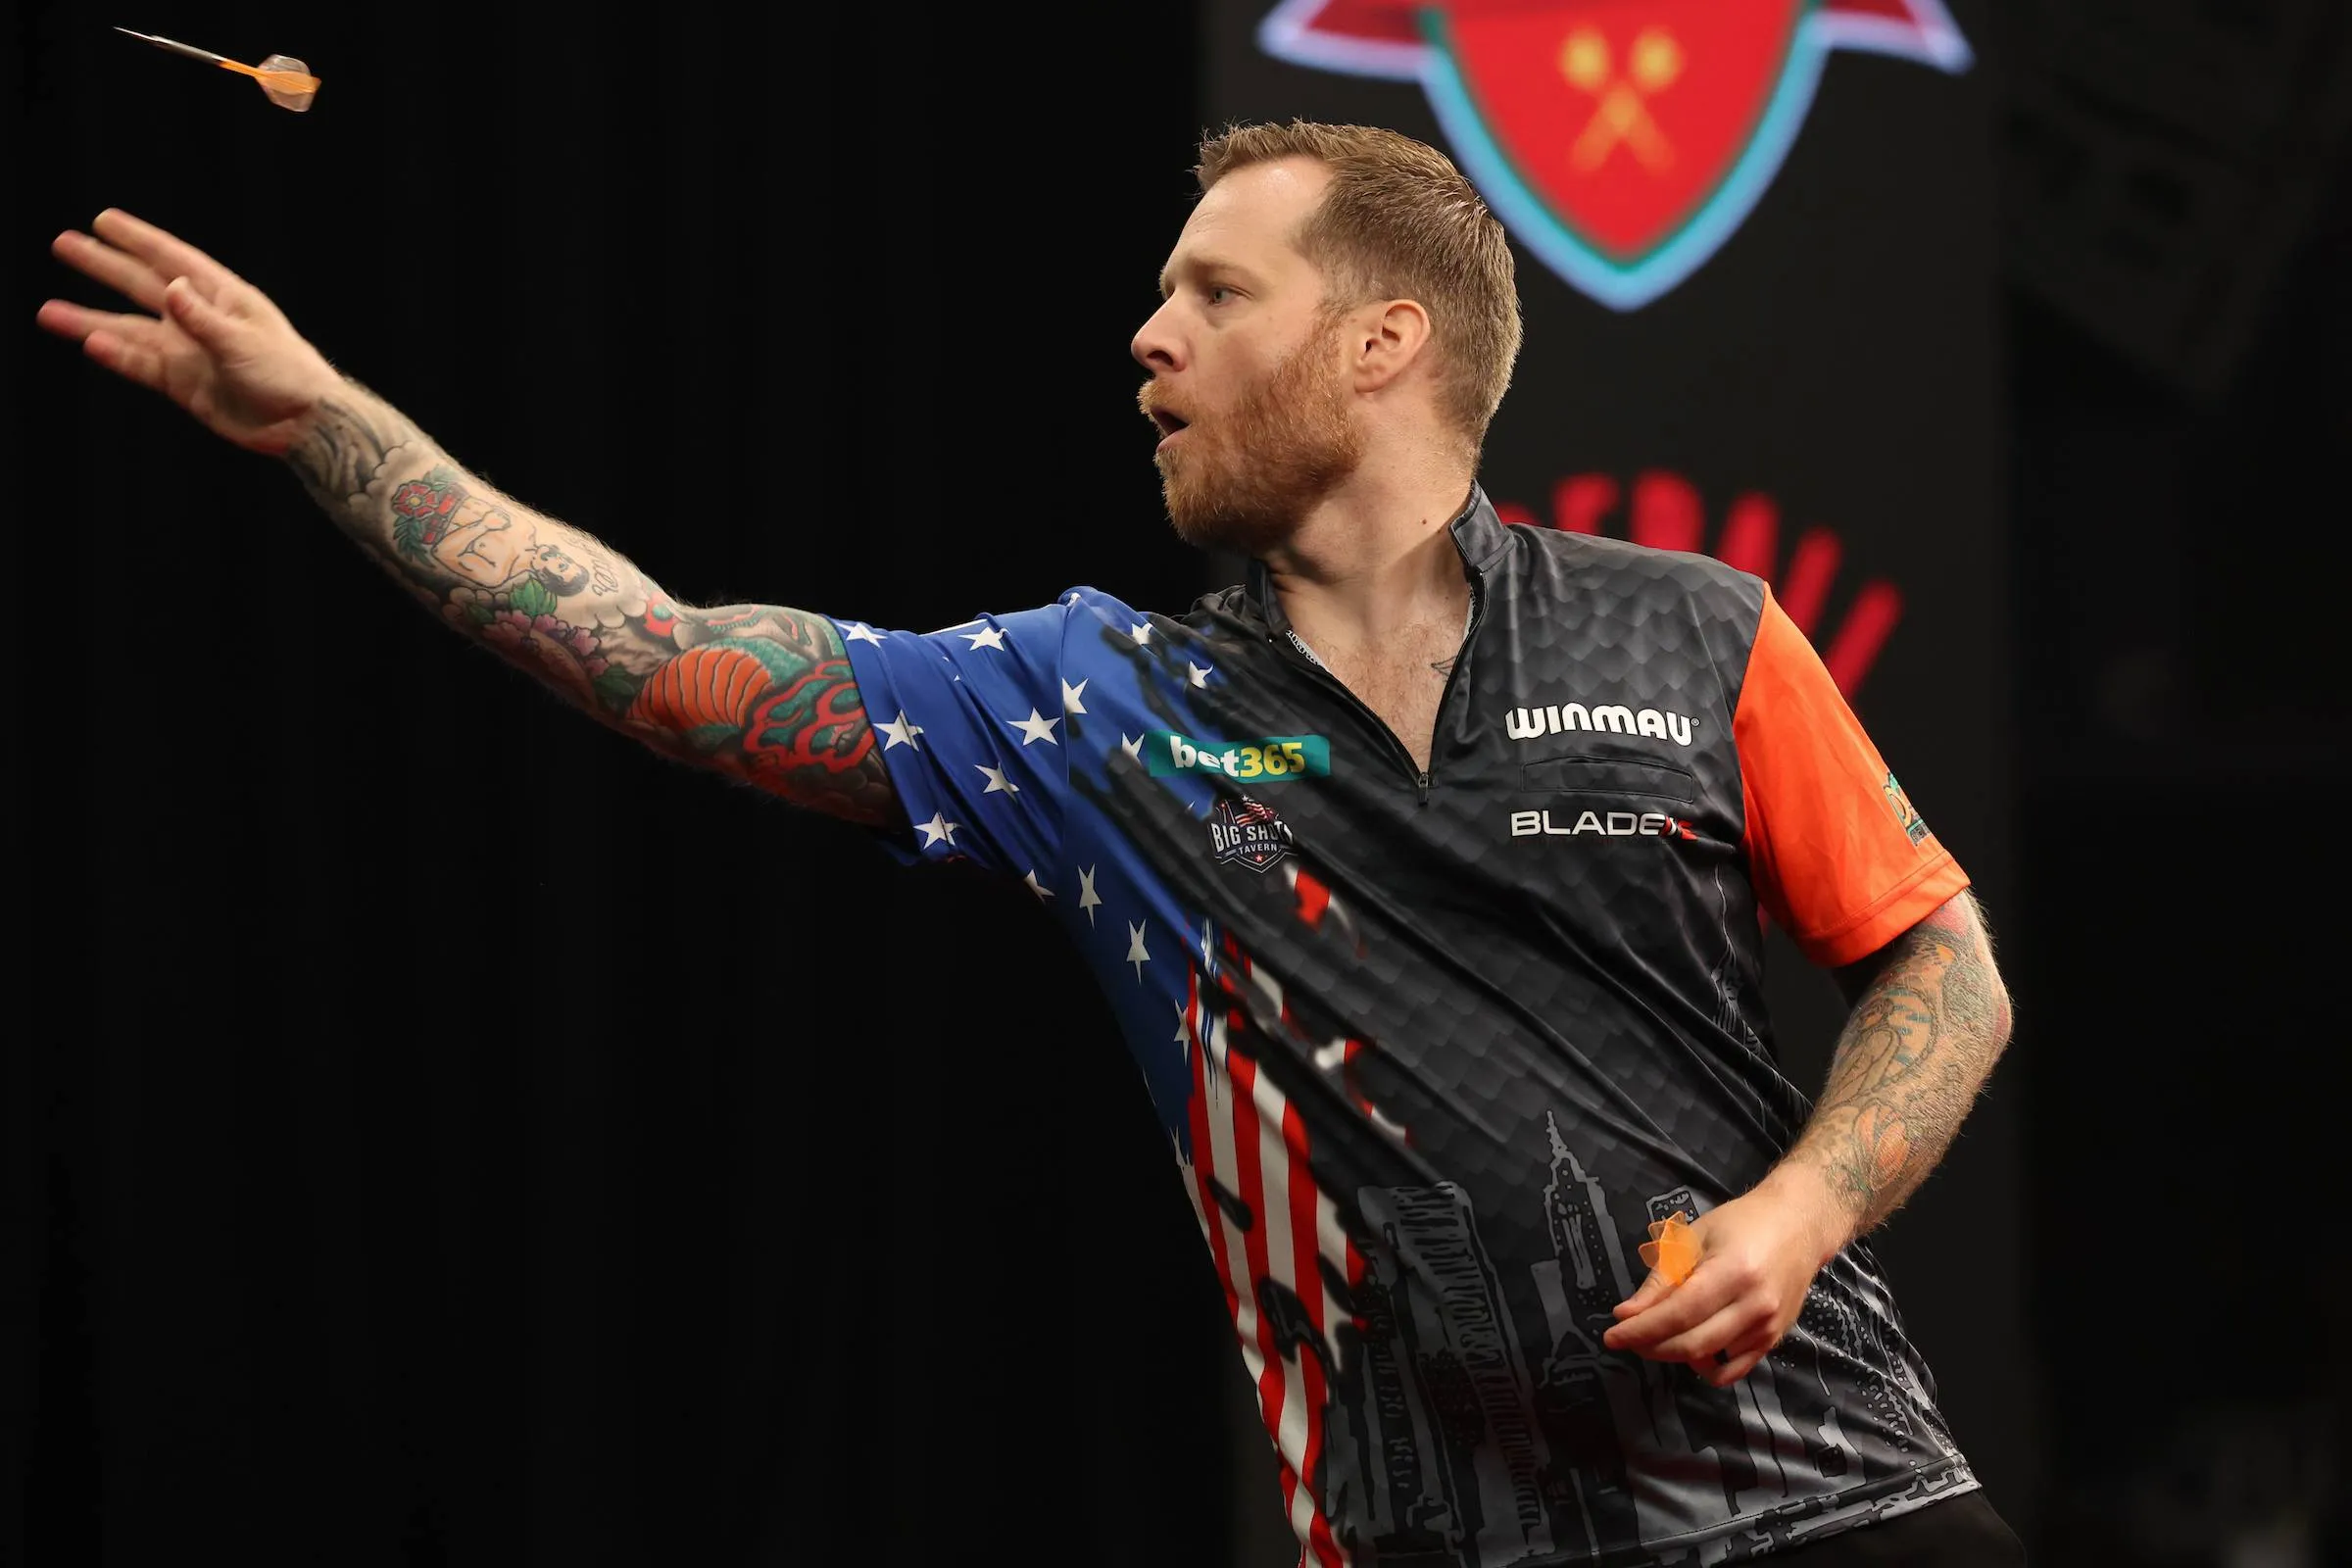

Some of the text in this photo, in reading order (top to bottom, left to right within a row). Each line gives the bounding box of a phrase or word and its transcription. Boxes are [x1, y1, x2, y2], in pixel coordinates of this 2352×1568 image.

[1170, 735, 1305, 777] bet365
[1210, 823, 1242, 853] BIG
[1238, 843, 1278, 856] TAVERN
